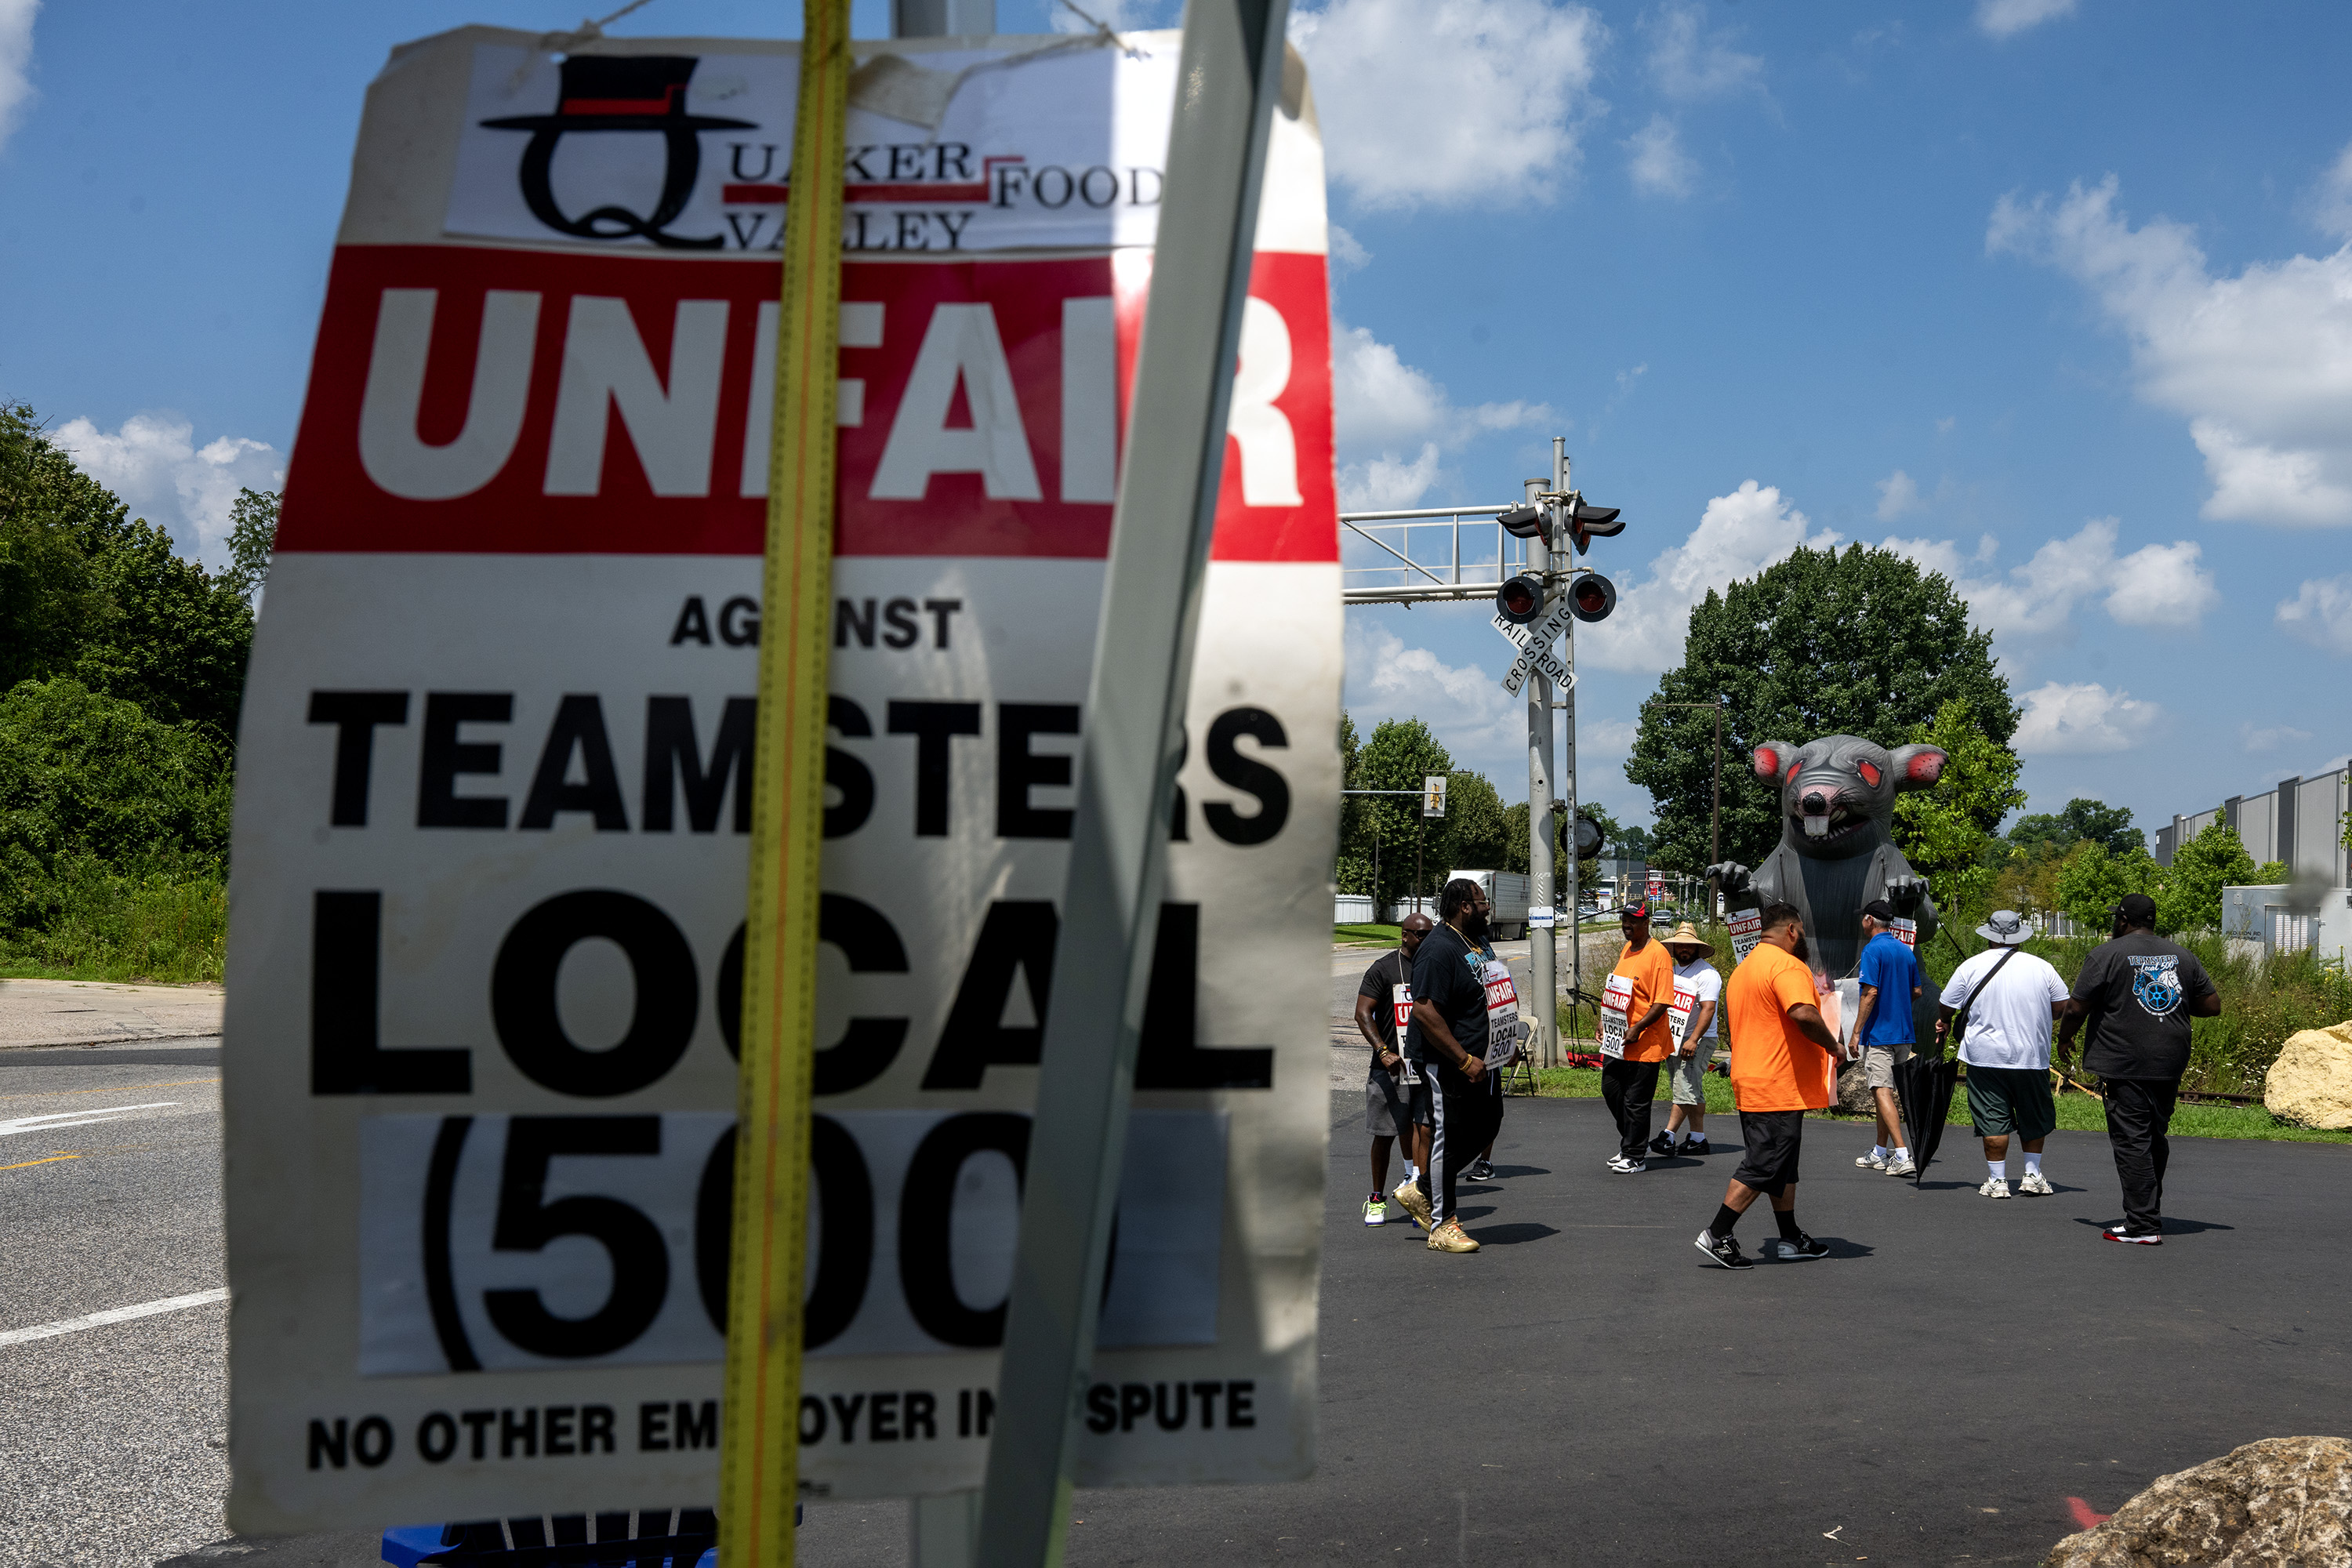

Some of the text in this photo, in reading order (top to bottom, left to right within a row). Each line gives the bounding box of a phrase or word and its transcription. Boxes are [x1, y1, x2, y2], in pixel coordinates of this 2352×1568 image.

[723, 211, 975, 251] VLEY
[670, 596, 962, 649] AGNST
[1505, 608, 1571, 691] CROSSING
[1730, 919, 1762, 935] UNFAIR
[1733, 935, 1762, 946] TEAMSTER
[2128, 955, 2179, 966] TEAMSTERS
[2141, 961, 2174, 972] Local 500
[310, 887, 1273, 1098] LOCAL
[1485, 980, 1515, 1007] UNFAIR
[1602, 990, 1629, 1011] UNFAIR
[1491, 1011, 1519, 1029] TEAMSTERS
[1602, 1014, 1627, 1028] TEAMSTERS
[1491, 1025, 1517, 1045] LOCAL
[307, 1414, 394, 1471] NO
[416, 1403, 616, 1464] OTHER
[638, 1389, 938, 1452] EMOYER
[1085, 1380, 1258, 1434] SPUTE
